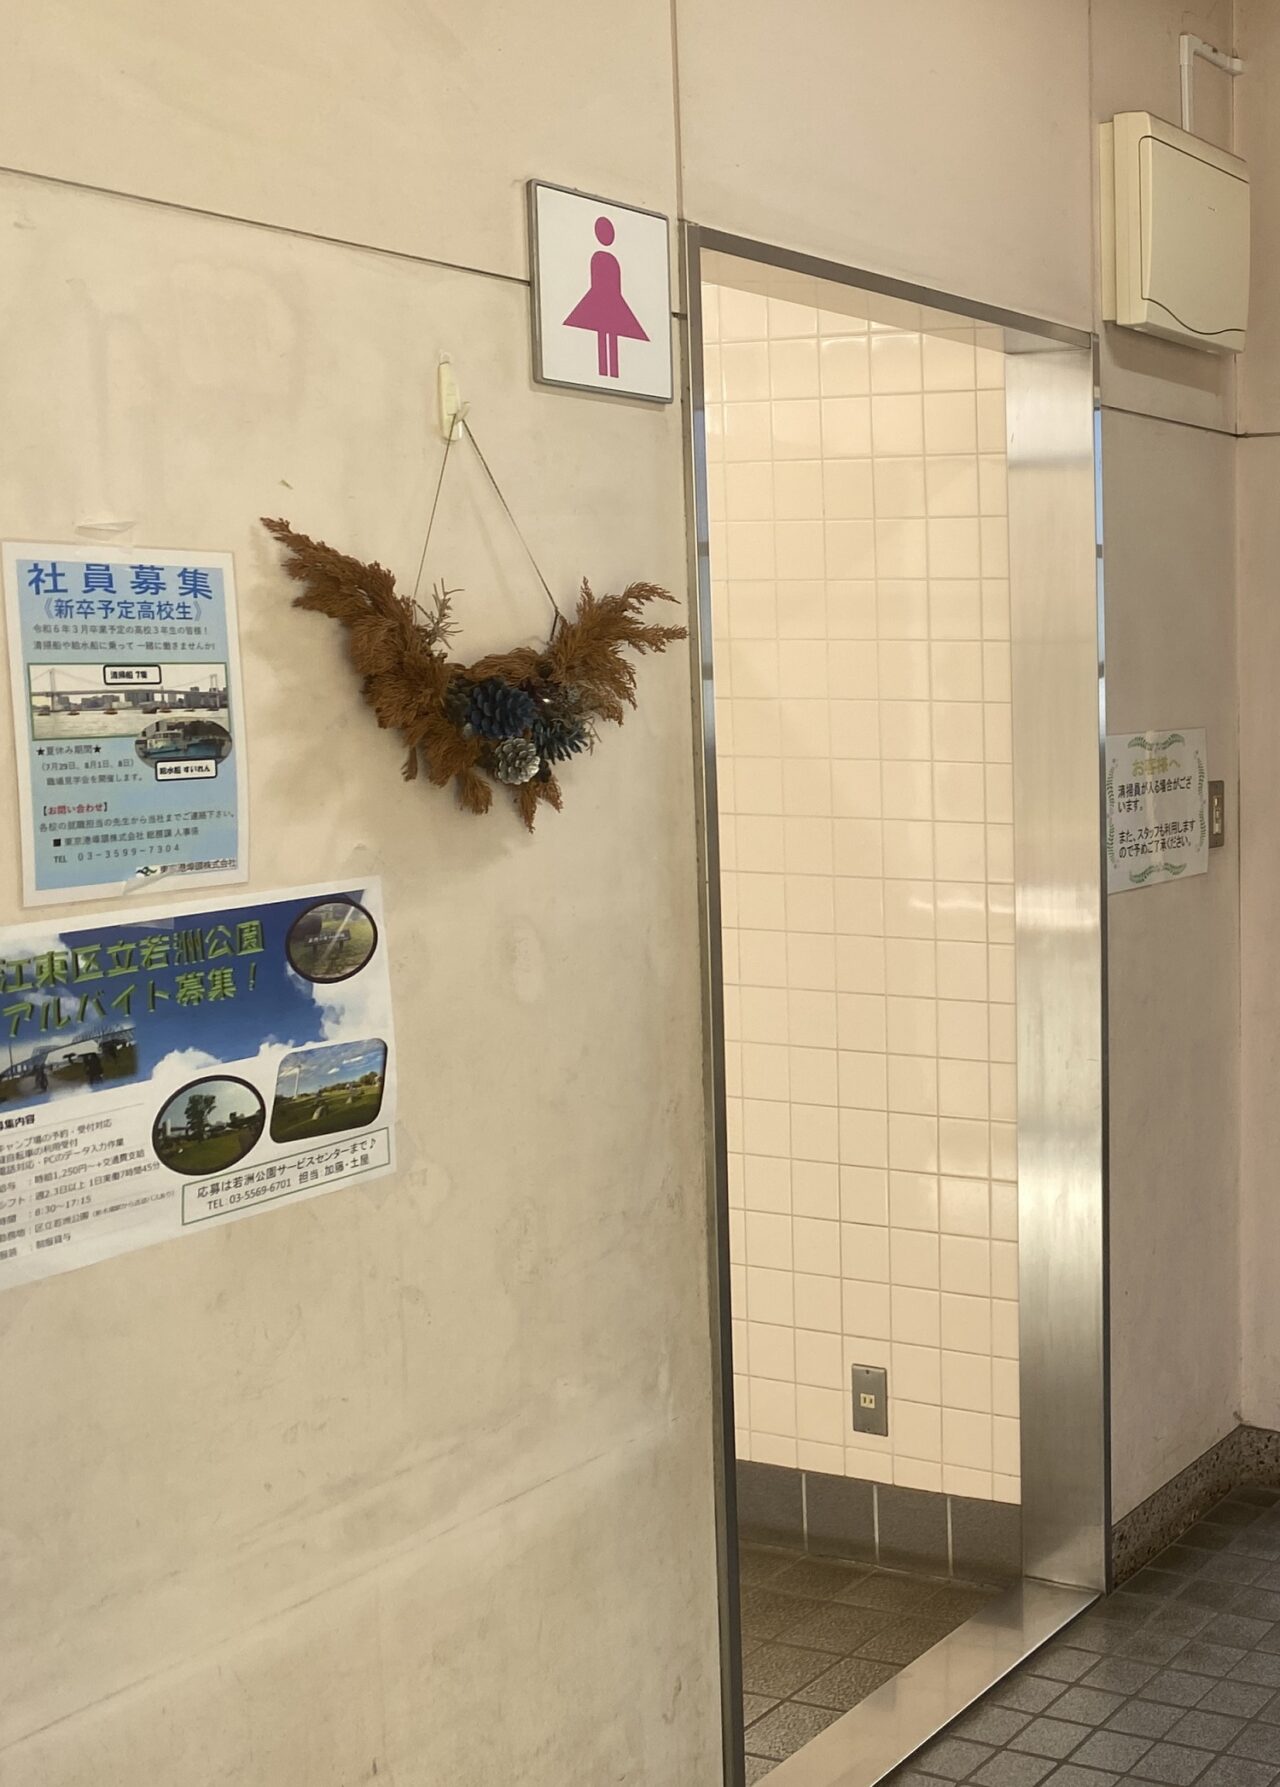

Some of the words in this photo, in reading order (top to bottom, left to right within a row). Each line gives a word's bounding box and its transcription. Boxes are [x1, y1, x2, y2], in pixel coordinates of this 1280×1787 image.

[27, 562, 213, 600] 社員募集
[1117, 799, 1143, 813] います。
[53, 855, 68, 864] TEL
[229, 1178, 292, 1205] 03-5569-6701
